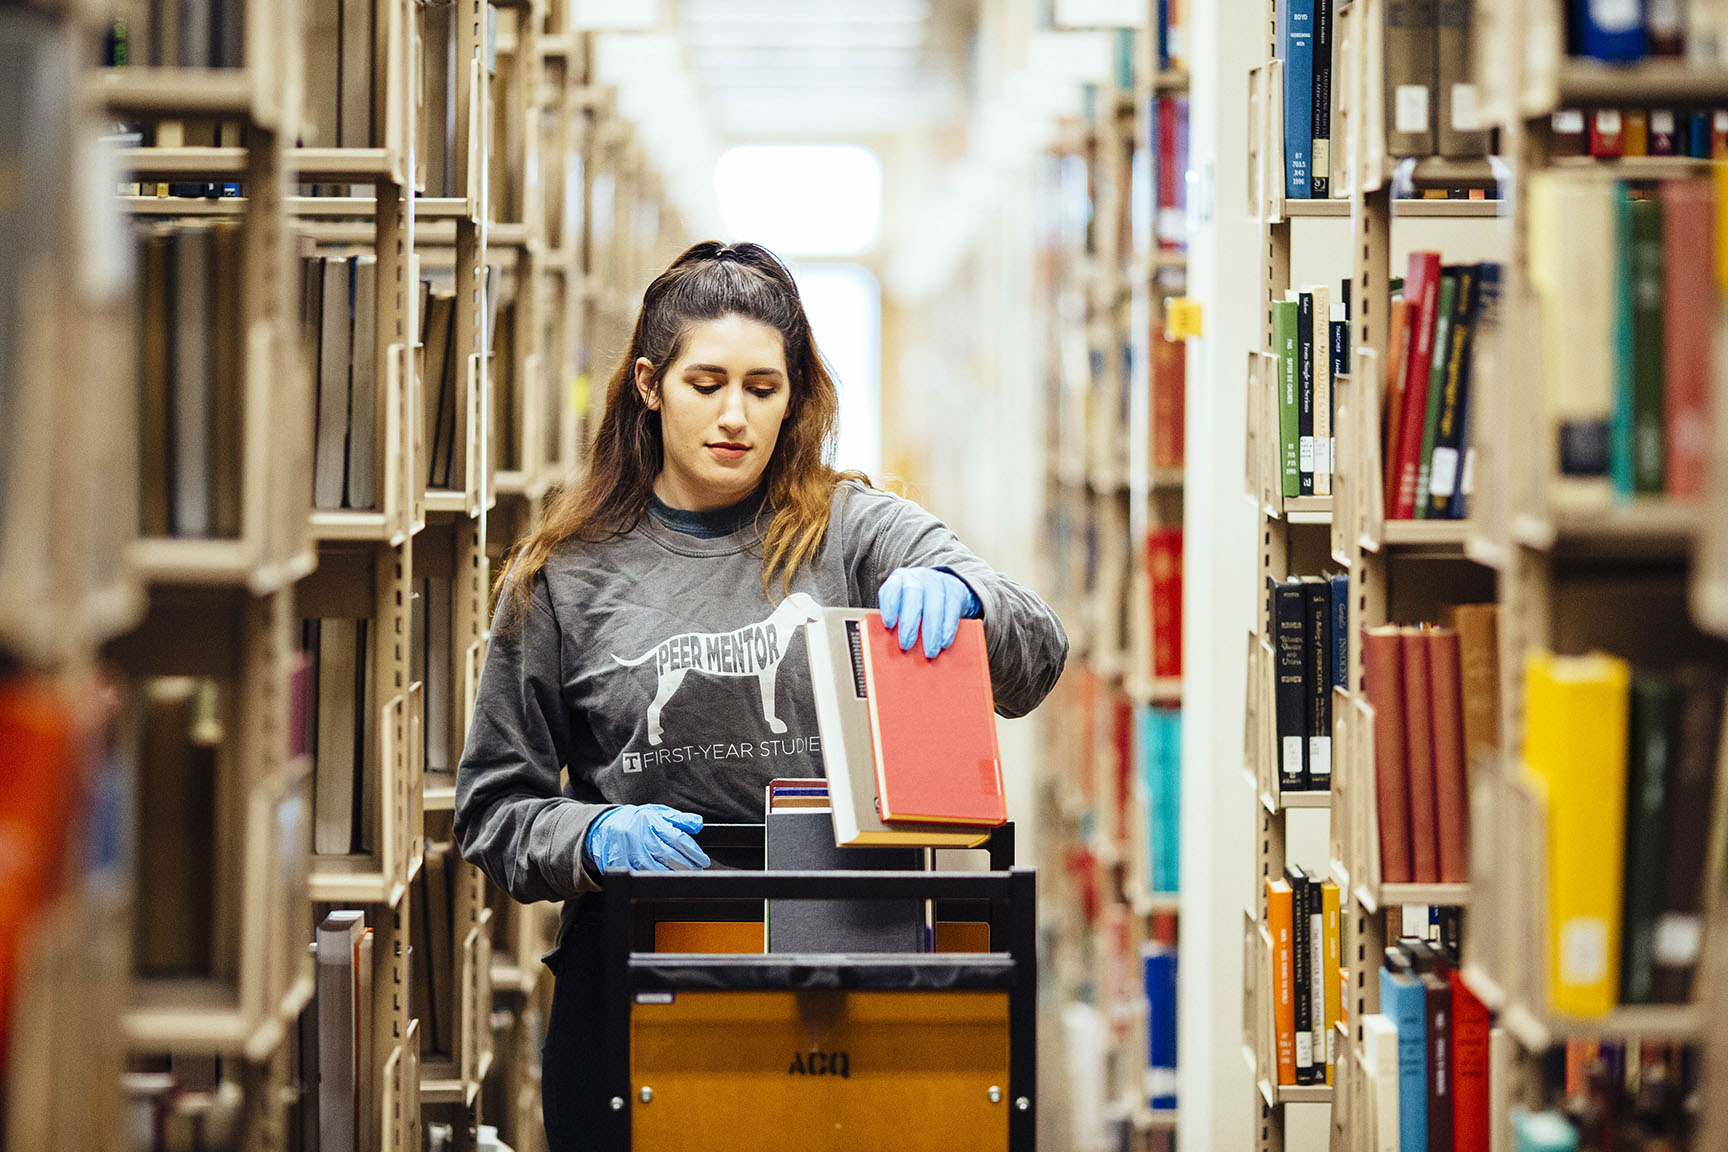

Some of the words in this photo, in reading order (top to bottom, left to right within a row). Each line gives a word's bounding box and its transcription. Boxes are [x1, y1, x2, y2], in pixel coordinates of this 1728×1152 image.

[1293, 13, 1308, 21] BOYD
[1302, 360, 1311, 380] Single
[1303, 389, 1311, 413] Serious
[657, 634, 704, 677] PEER
[706, 623, 781, 674] MENTOR
[643, 743, 754, 768] FIRST-YEAR
[760, 735, 821, 757] STUDIE
[789, 1051, 850, 1078] ACQ
